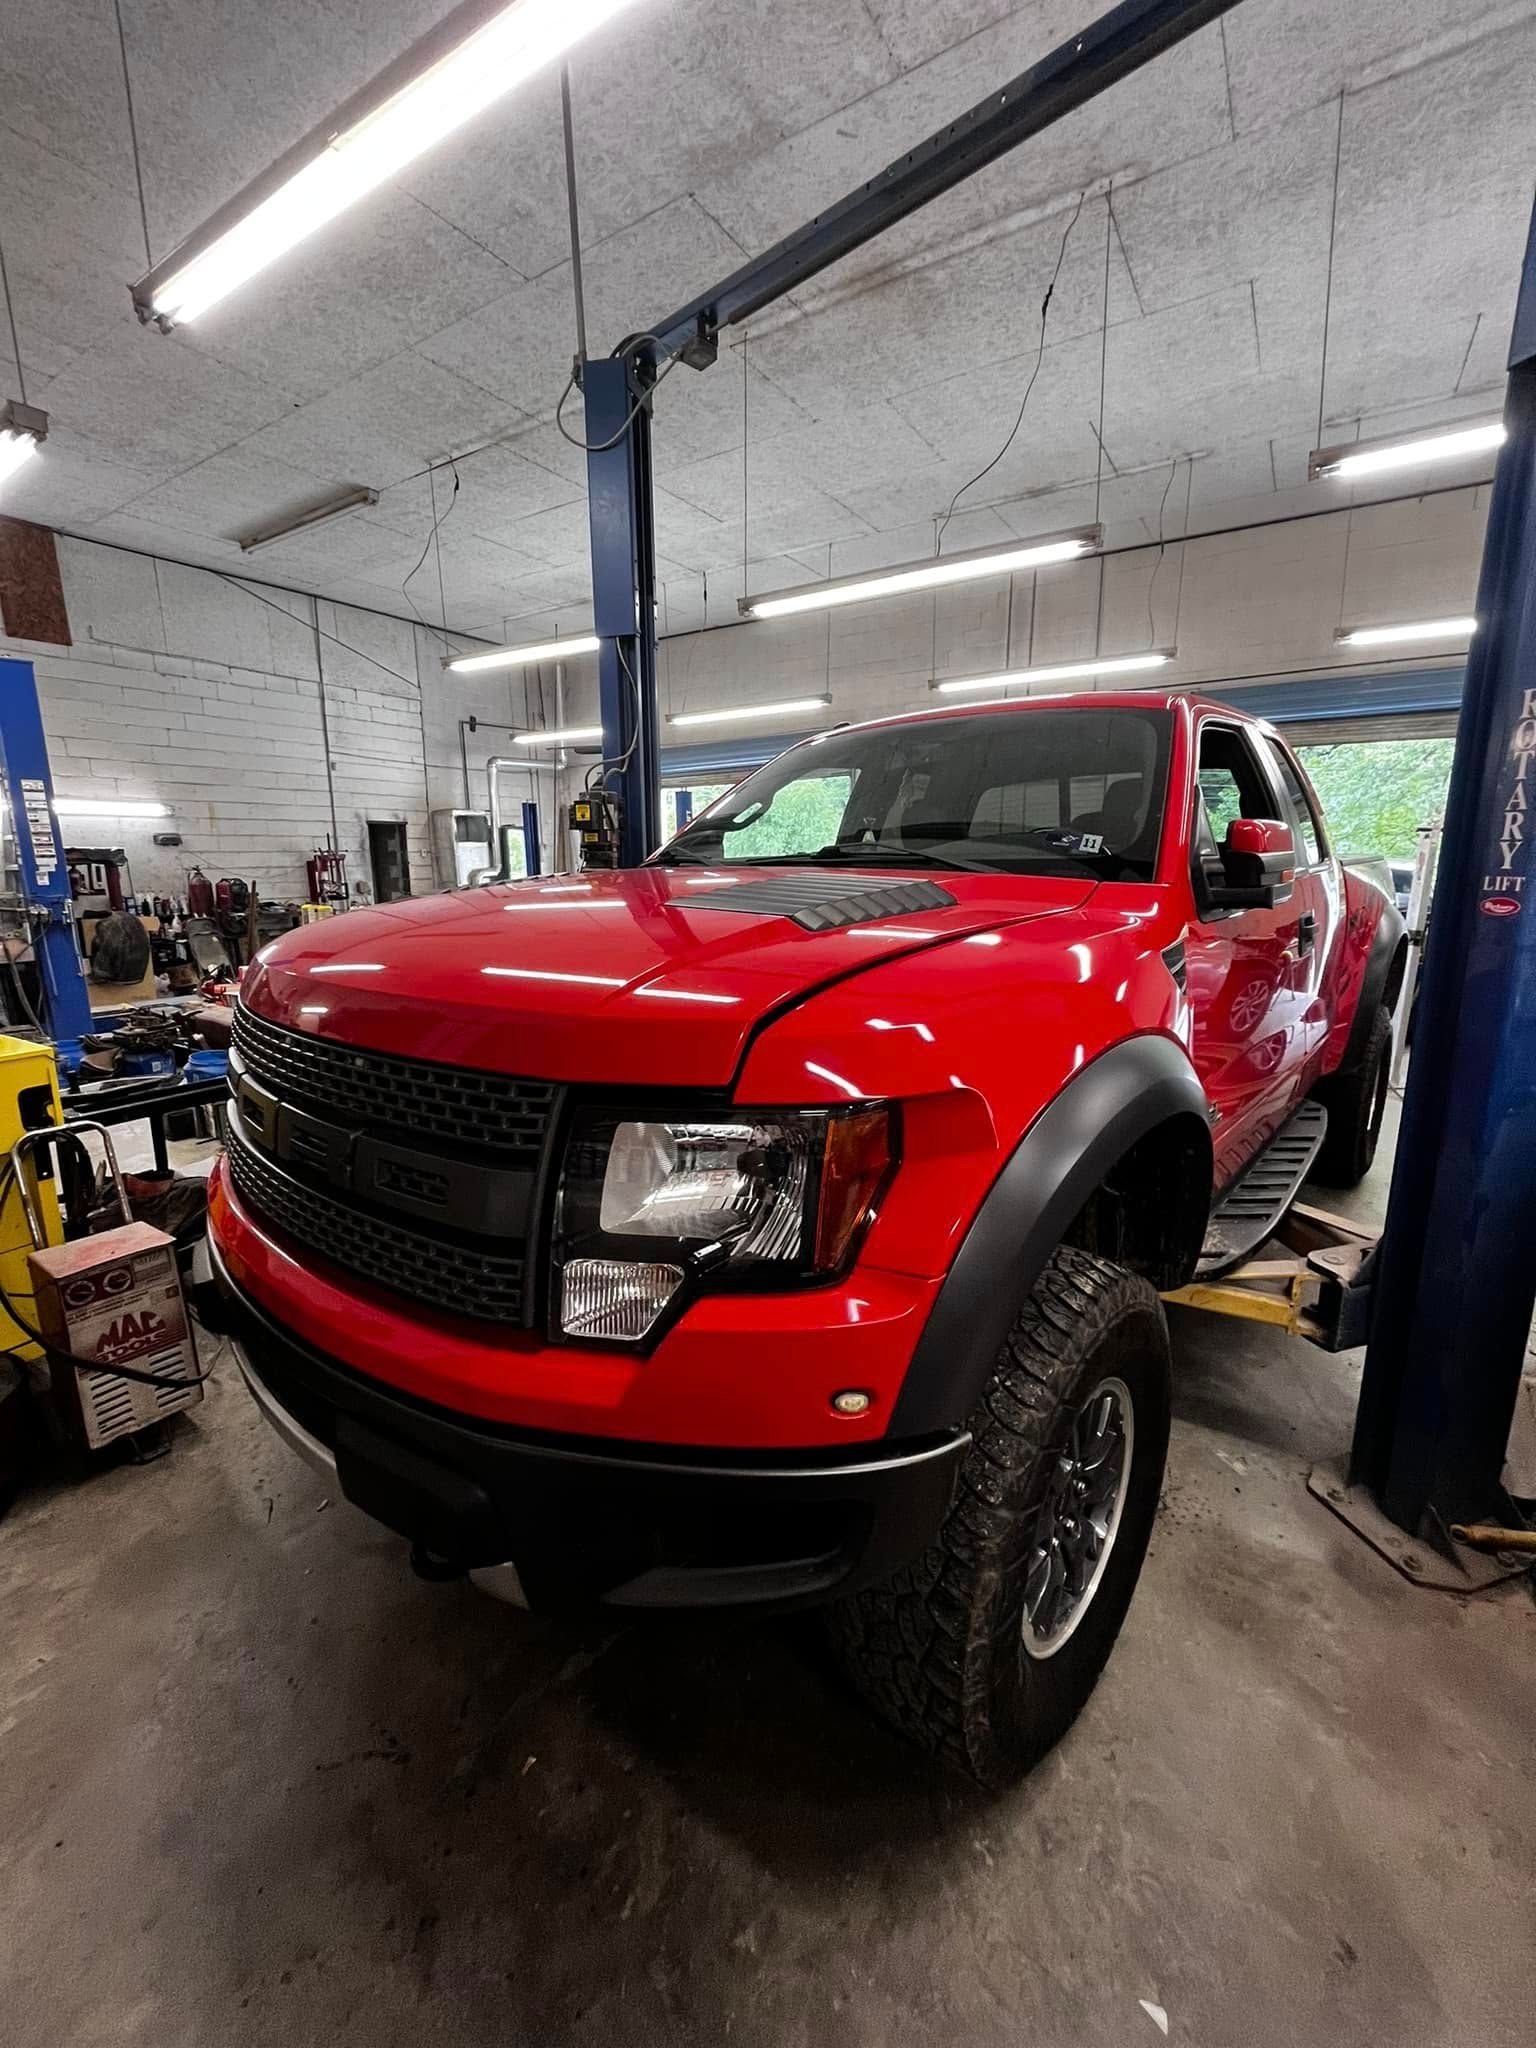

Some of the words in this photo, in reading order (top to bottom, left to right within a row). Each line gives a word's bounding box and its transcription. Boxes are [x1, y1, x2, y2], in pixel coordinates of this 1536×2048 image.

[1499, 688, 1536, 869] ROTARY
[1084, 838, 1097, 848] 11
[1482, 875, 1526, 892] LIFT
[97, 1310, 166, 1354] MAC
